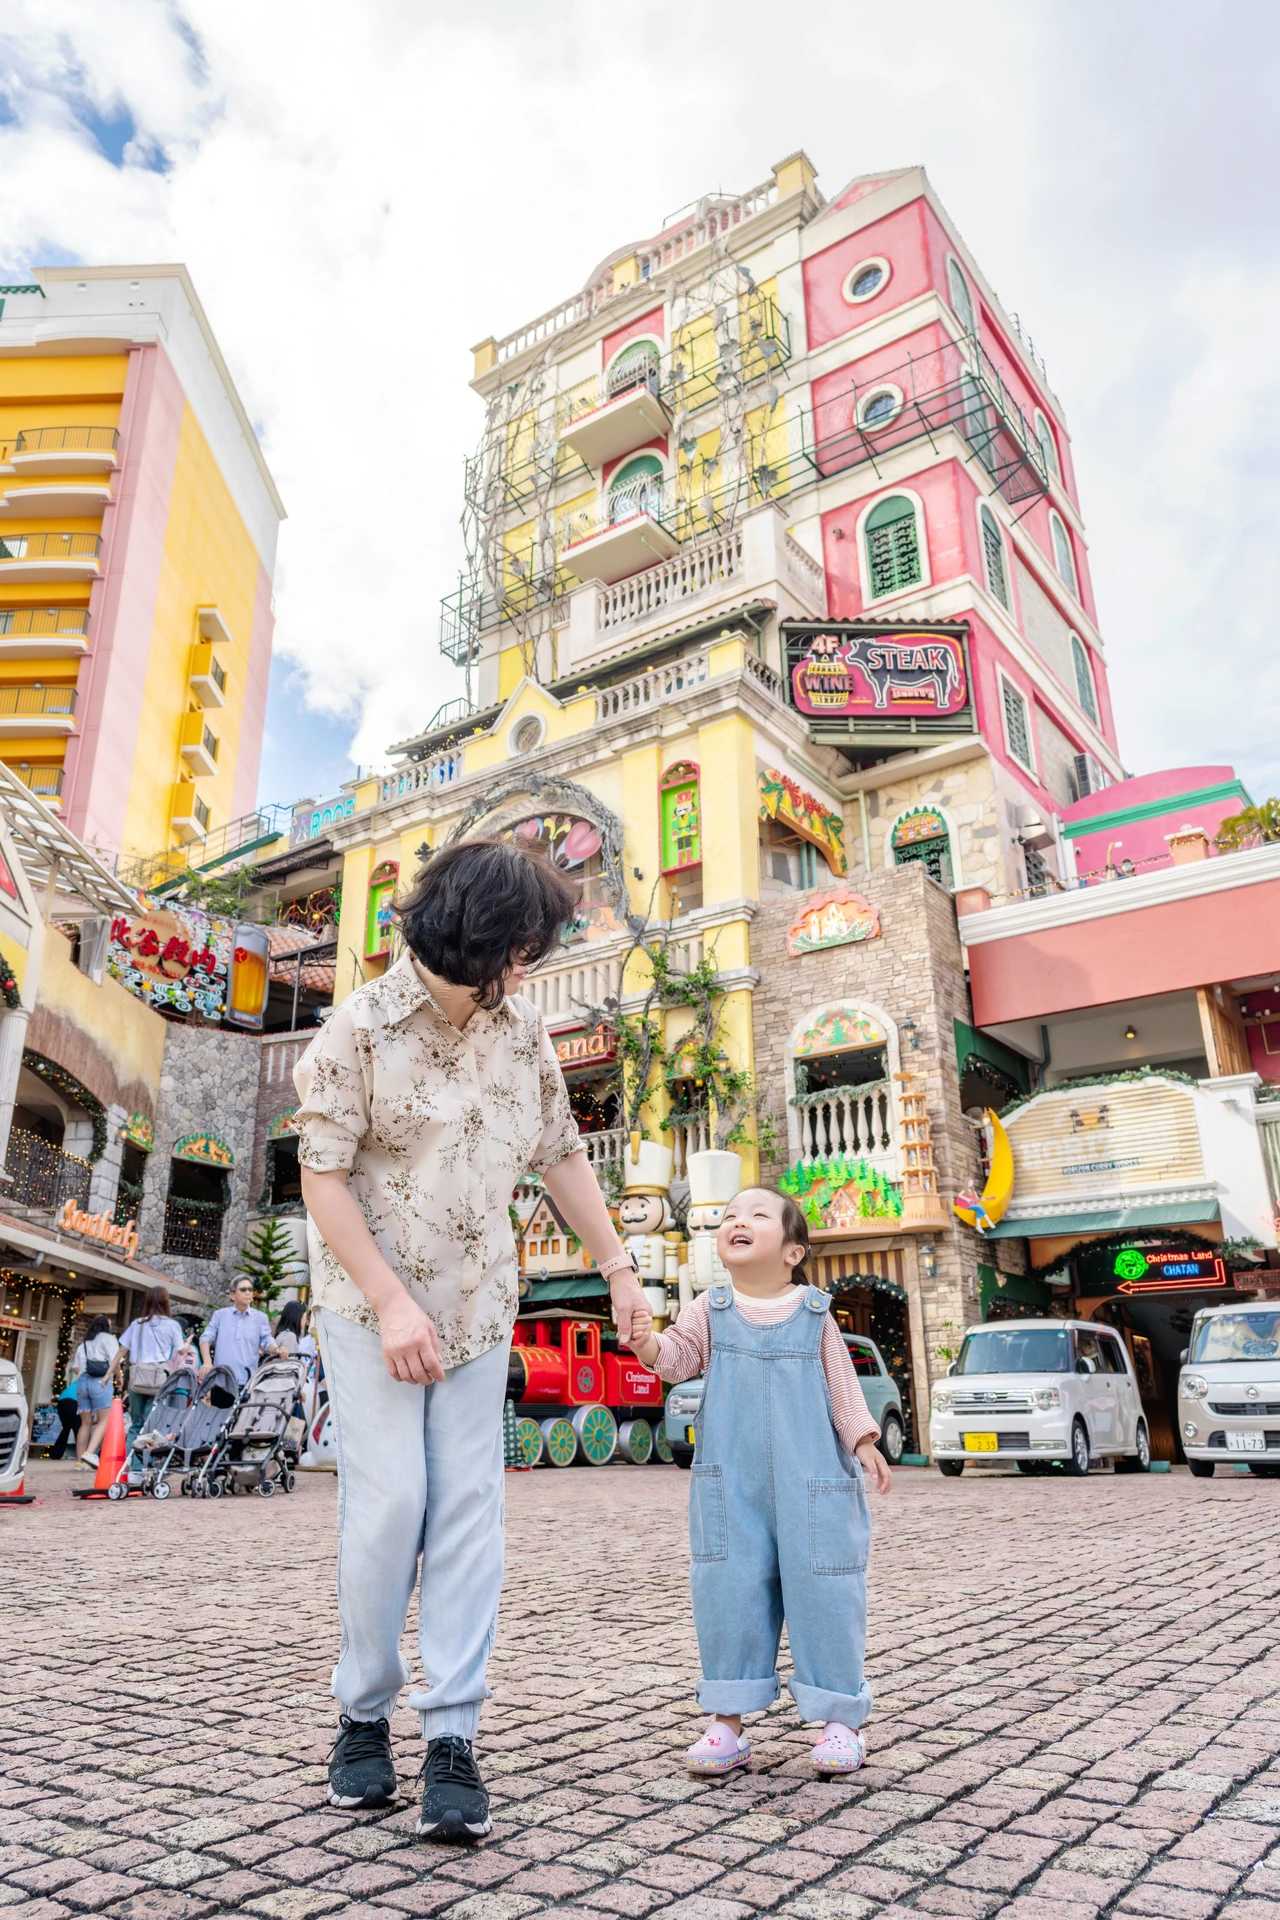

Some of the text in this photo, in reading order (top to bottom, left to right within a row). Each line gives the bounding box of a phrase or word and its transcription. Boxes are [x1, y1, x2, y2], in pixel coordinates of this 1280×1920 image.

[811, 635, 839, 655] 4F
[868, 647, 946, 671] STEAK
[804, 674, 855, 692] WINE
[1063, 1158, 1139, 1175] HORIZON CURRY WORKS
[58, 1198, 139, 1261] Southerly
[1146, 1250, 1213, 1264] Christmas Land
[1163, 1264, 1199, 1277] CHATAN
[625, 1370, 656, 1384] Christmas
[633, 1383, 650, 1395] Land
